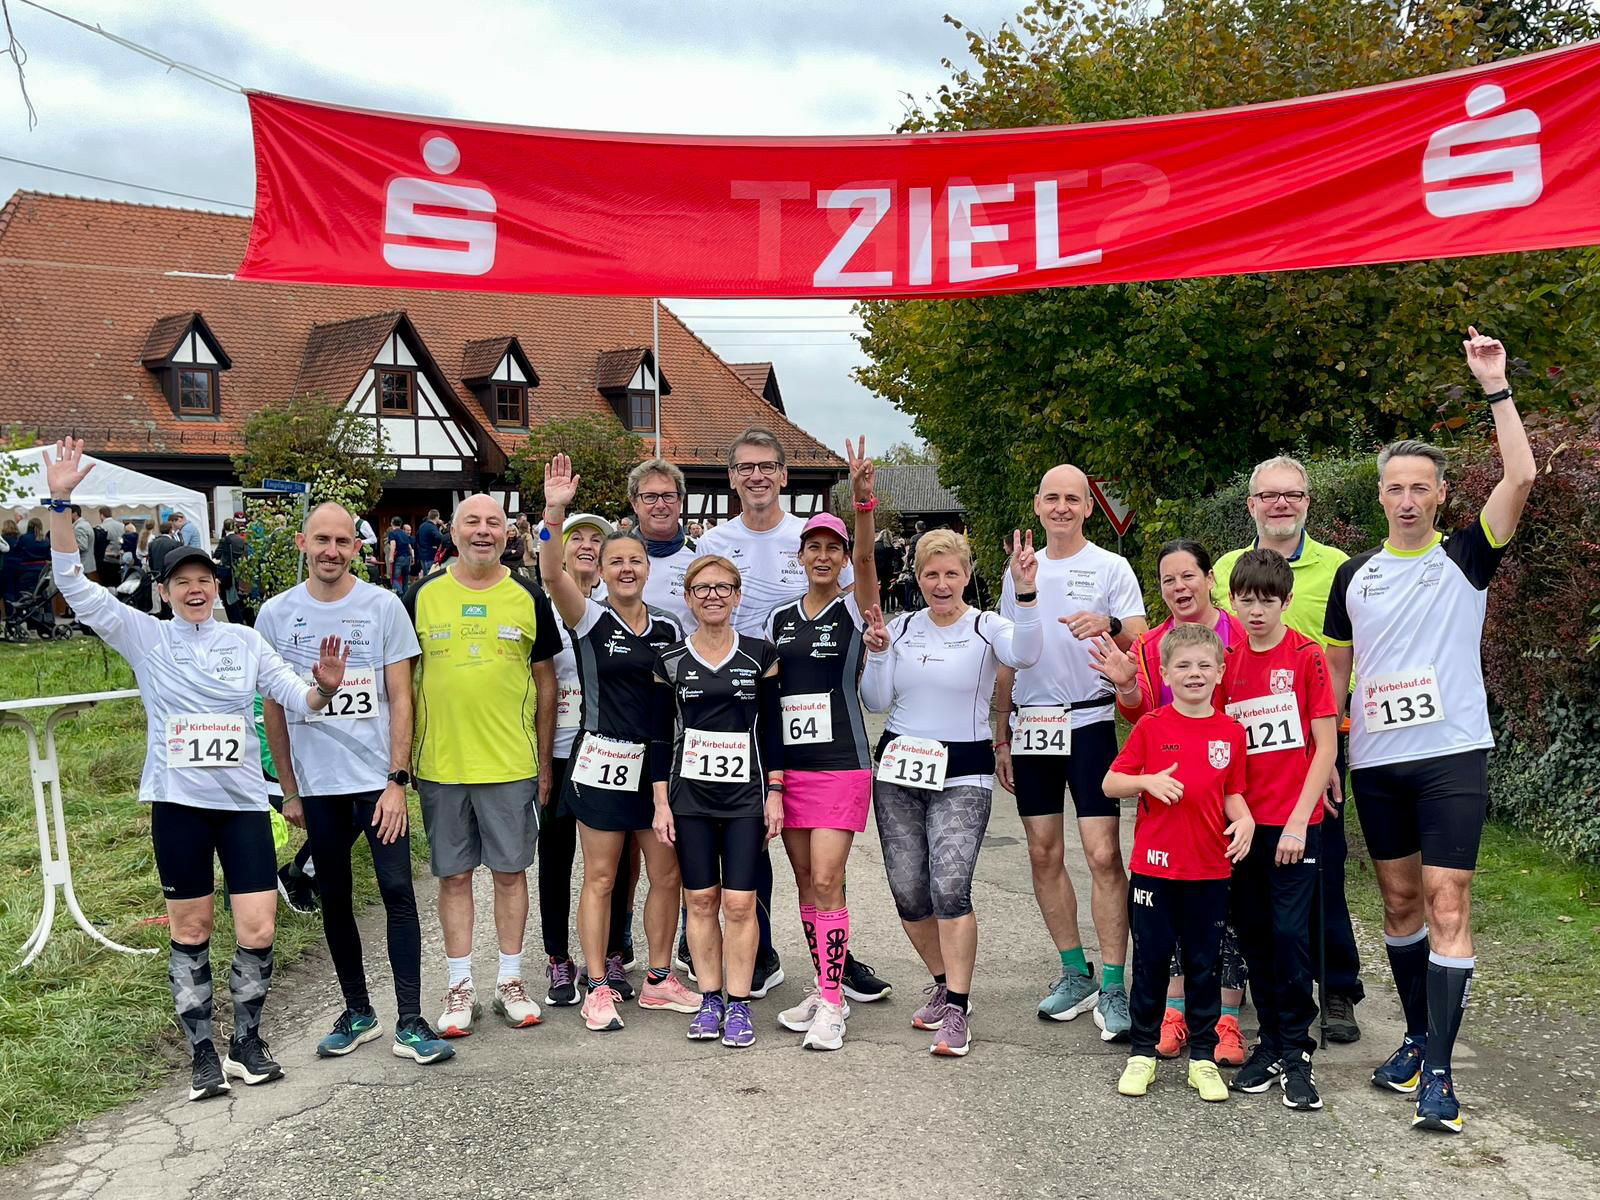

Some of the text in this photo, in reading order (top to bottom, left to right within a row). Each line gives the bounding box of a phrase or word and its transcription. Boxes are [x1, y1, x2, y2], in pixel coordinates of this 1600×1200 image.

[813, 180, 1102, 288] ZIEL
[1378, 677, 1432, 693] Kirbelauf.de
[324, 691, 372, 717] 123
[785, 703, 827, 712] Kirbelauf.de
[1243, 703, 1293, 718] Kirbelauf.de
[1380, 693, 1436, 725] 133
[190, 723, 241, 732] Kirbelauf.de
[789, 717, 819, 740] 64
[1026, 715, 1068, 724] Kirbelauf.de
[702, 741, 746, 750] Kirbelauf.de
[1023, 729, 1066, 751] 134
[1246, 719, 1297, 750] 121
[188, 738, 239, 761] 142
[597, 747, 640, 760] Kirbelauf.de
[901, 744, 944, 758] Kirbelauf.de
[597, 764, 629, 786] 18
[699, 755, 744, 778] 132
[895, 758, 938, 785] 131
[1147, 849, 1169, 867] NFK
[1133, 887, 1153, 907] NFK
[825, 927, 849, 990] eleven
